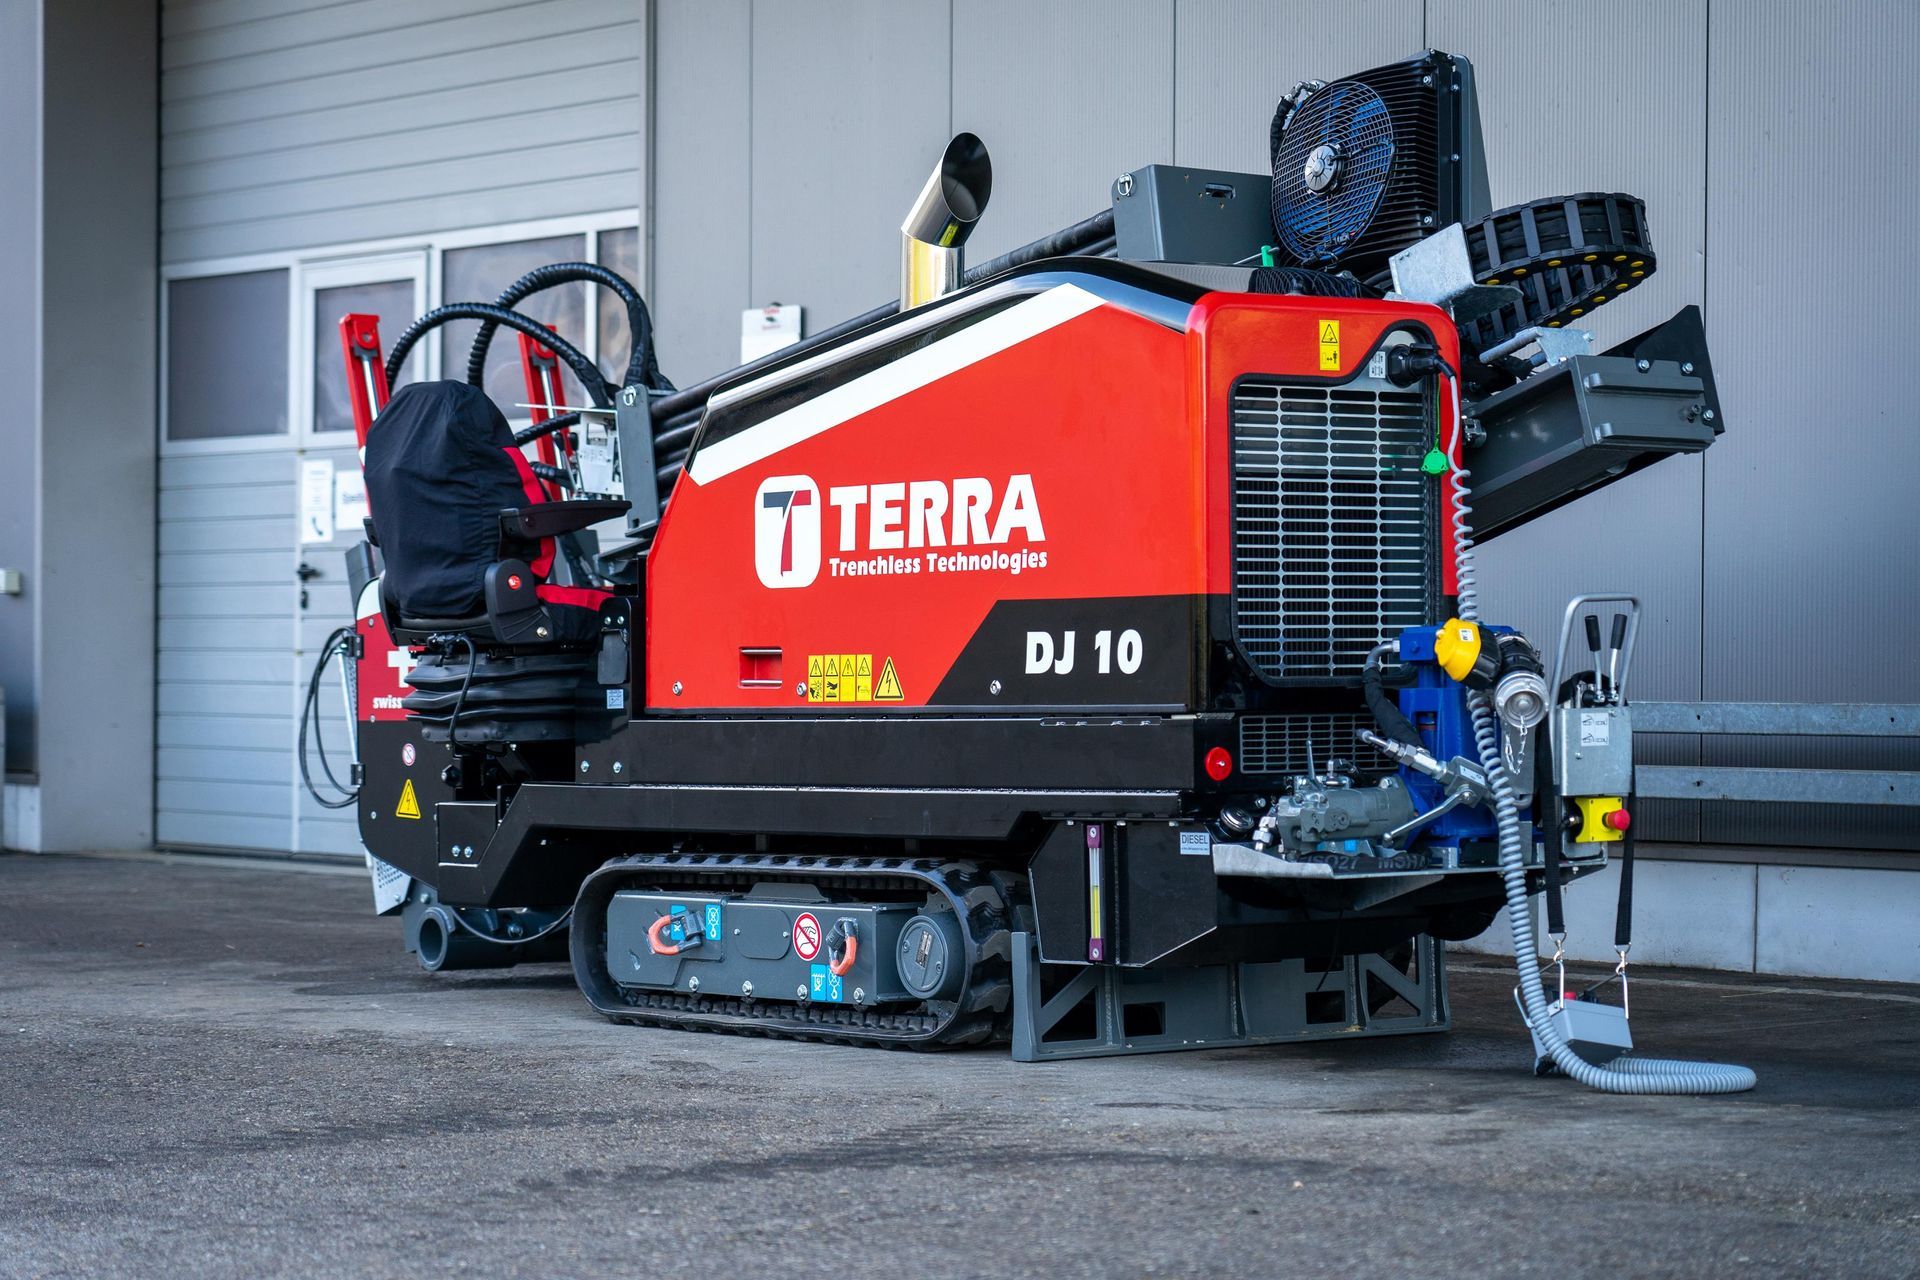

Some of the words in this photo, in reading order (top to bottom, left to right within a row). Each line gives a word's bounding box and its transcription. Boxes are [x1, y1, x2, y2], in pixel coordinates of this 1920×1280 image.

[829, 473, 1046, 552] TERRA
[829, 554, 921, 577] Trenchless
[926, 549, 1048, 574] Technologies
[1025, 630, 1076, 675] DJ
[1094, 629, 1143, 675] 10
[373, 694, 403, 709] swiss
[1181, 834, 1208, 845] DIESEL
